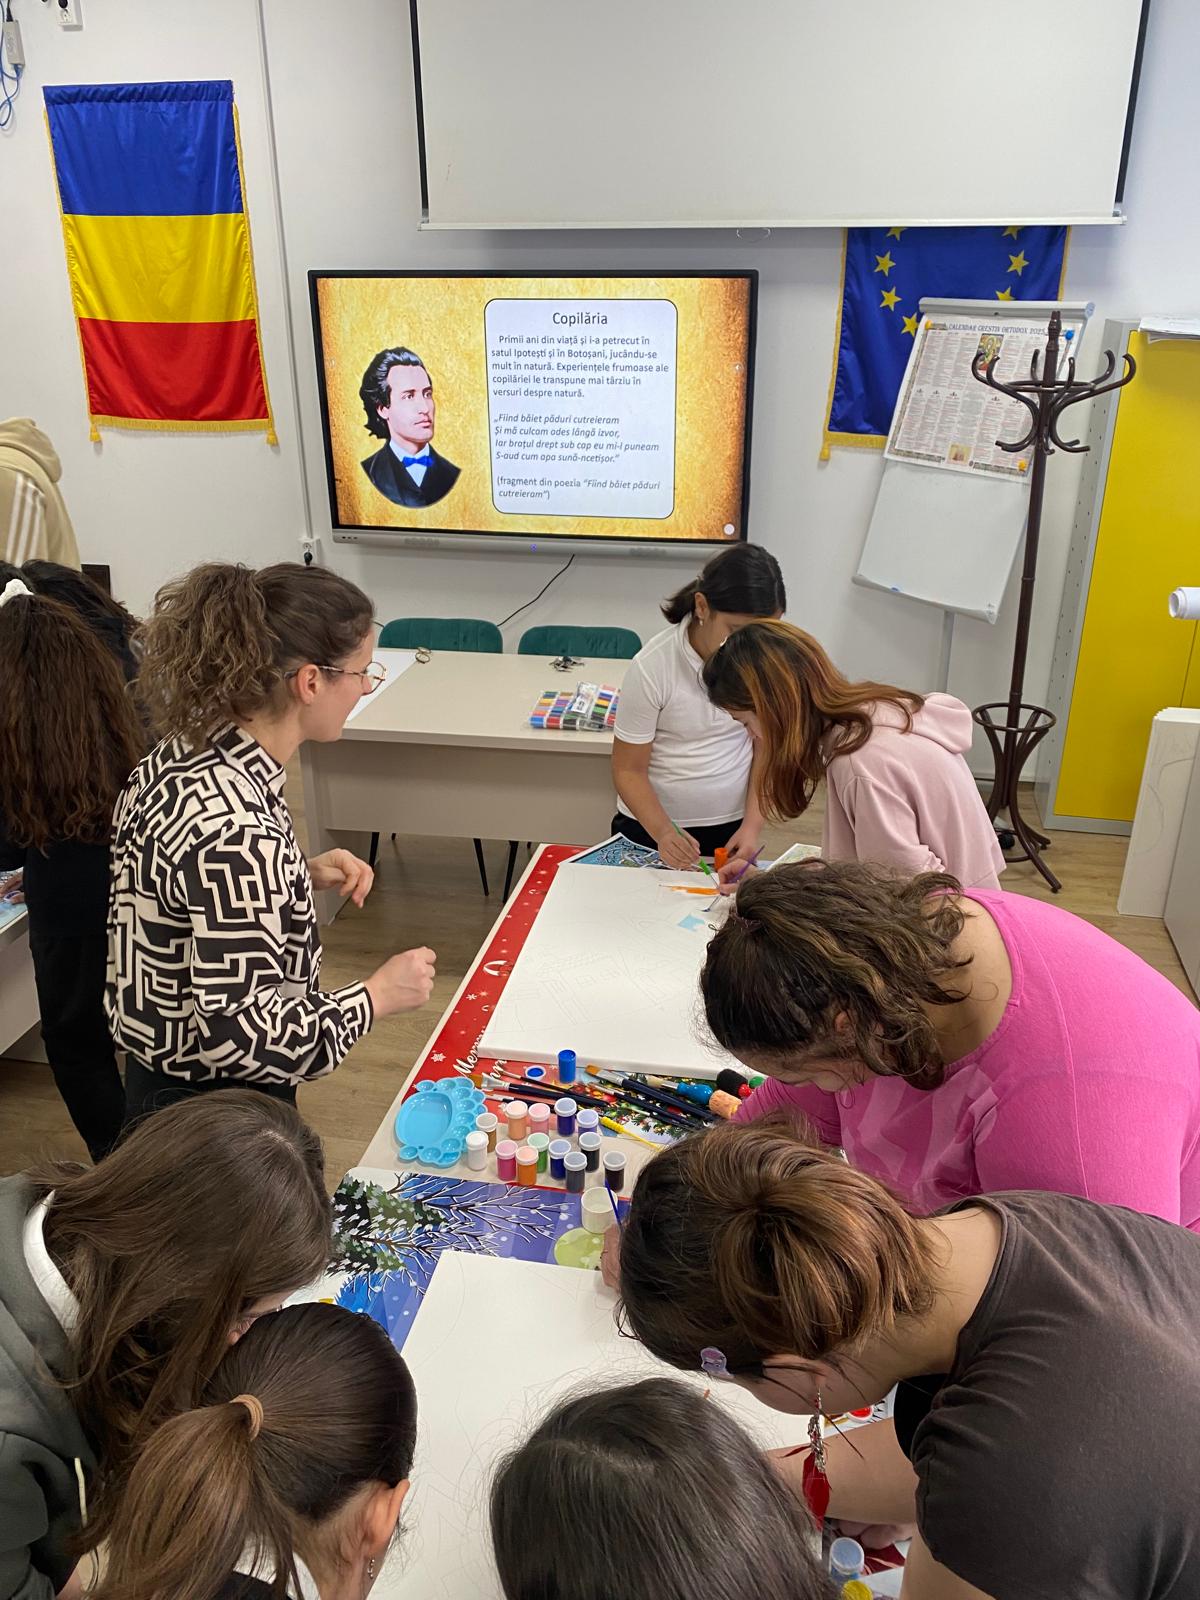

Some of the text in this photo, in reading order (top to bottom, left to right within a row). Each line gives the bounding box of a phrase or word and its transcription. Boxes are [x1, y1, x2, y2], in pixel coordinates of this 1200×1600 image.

[553, 312, 607, 326] Copilăria
[499, 336, 524, 344] Primii
[526, 336, 539, 344] ani
[542, 336, 555, 344] din
[589, 336, 600, 344] i-a
[603, 337, 639, 346] petrecut
[641, 336, 649, 345] în
[609, 350, 657, 360] jucându-se
[613, 364, 653, 372] frumoase
[656, 364, 669, 372] ale
[493, 376, 531, 386] copilăriei
[543, 376, 585, 386] transpune
[606, 377, 630, 385] târziu
[633, 377, 641, 385] în
[493, 388, 585, 398] versuri despre natură.
[521, 414, 542, 422] băiet
[544, 415, 571, 425] păduri
[574, 416, 619, 424] cutreieram
[572, 429, 596, 438] lângă
[598, 429, 620, 438] izvor,
[536, 441, 557, 450] drept
[560, 441, 574, 449] sub
[577, 442, 591, 451] cap
[624, 444, 659, 452] puneam
[541, 454, 555, 462] apa
[497, 476, 537, 487] (fragment
[555, 480, 581, 489] poezia
[609, 481, 630, 489] băiet
[633, 482, 660, 491] păduri
